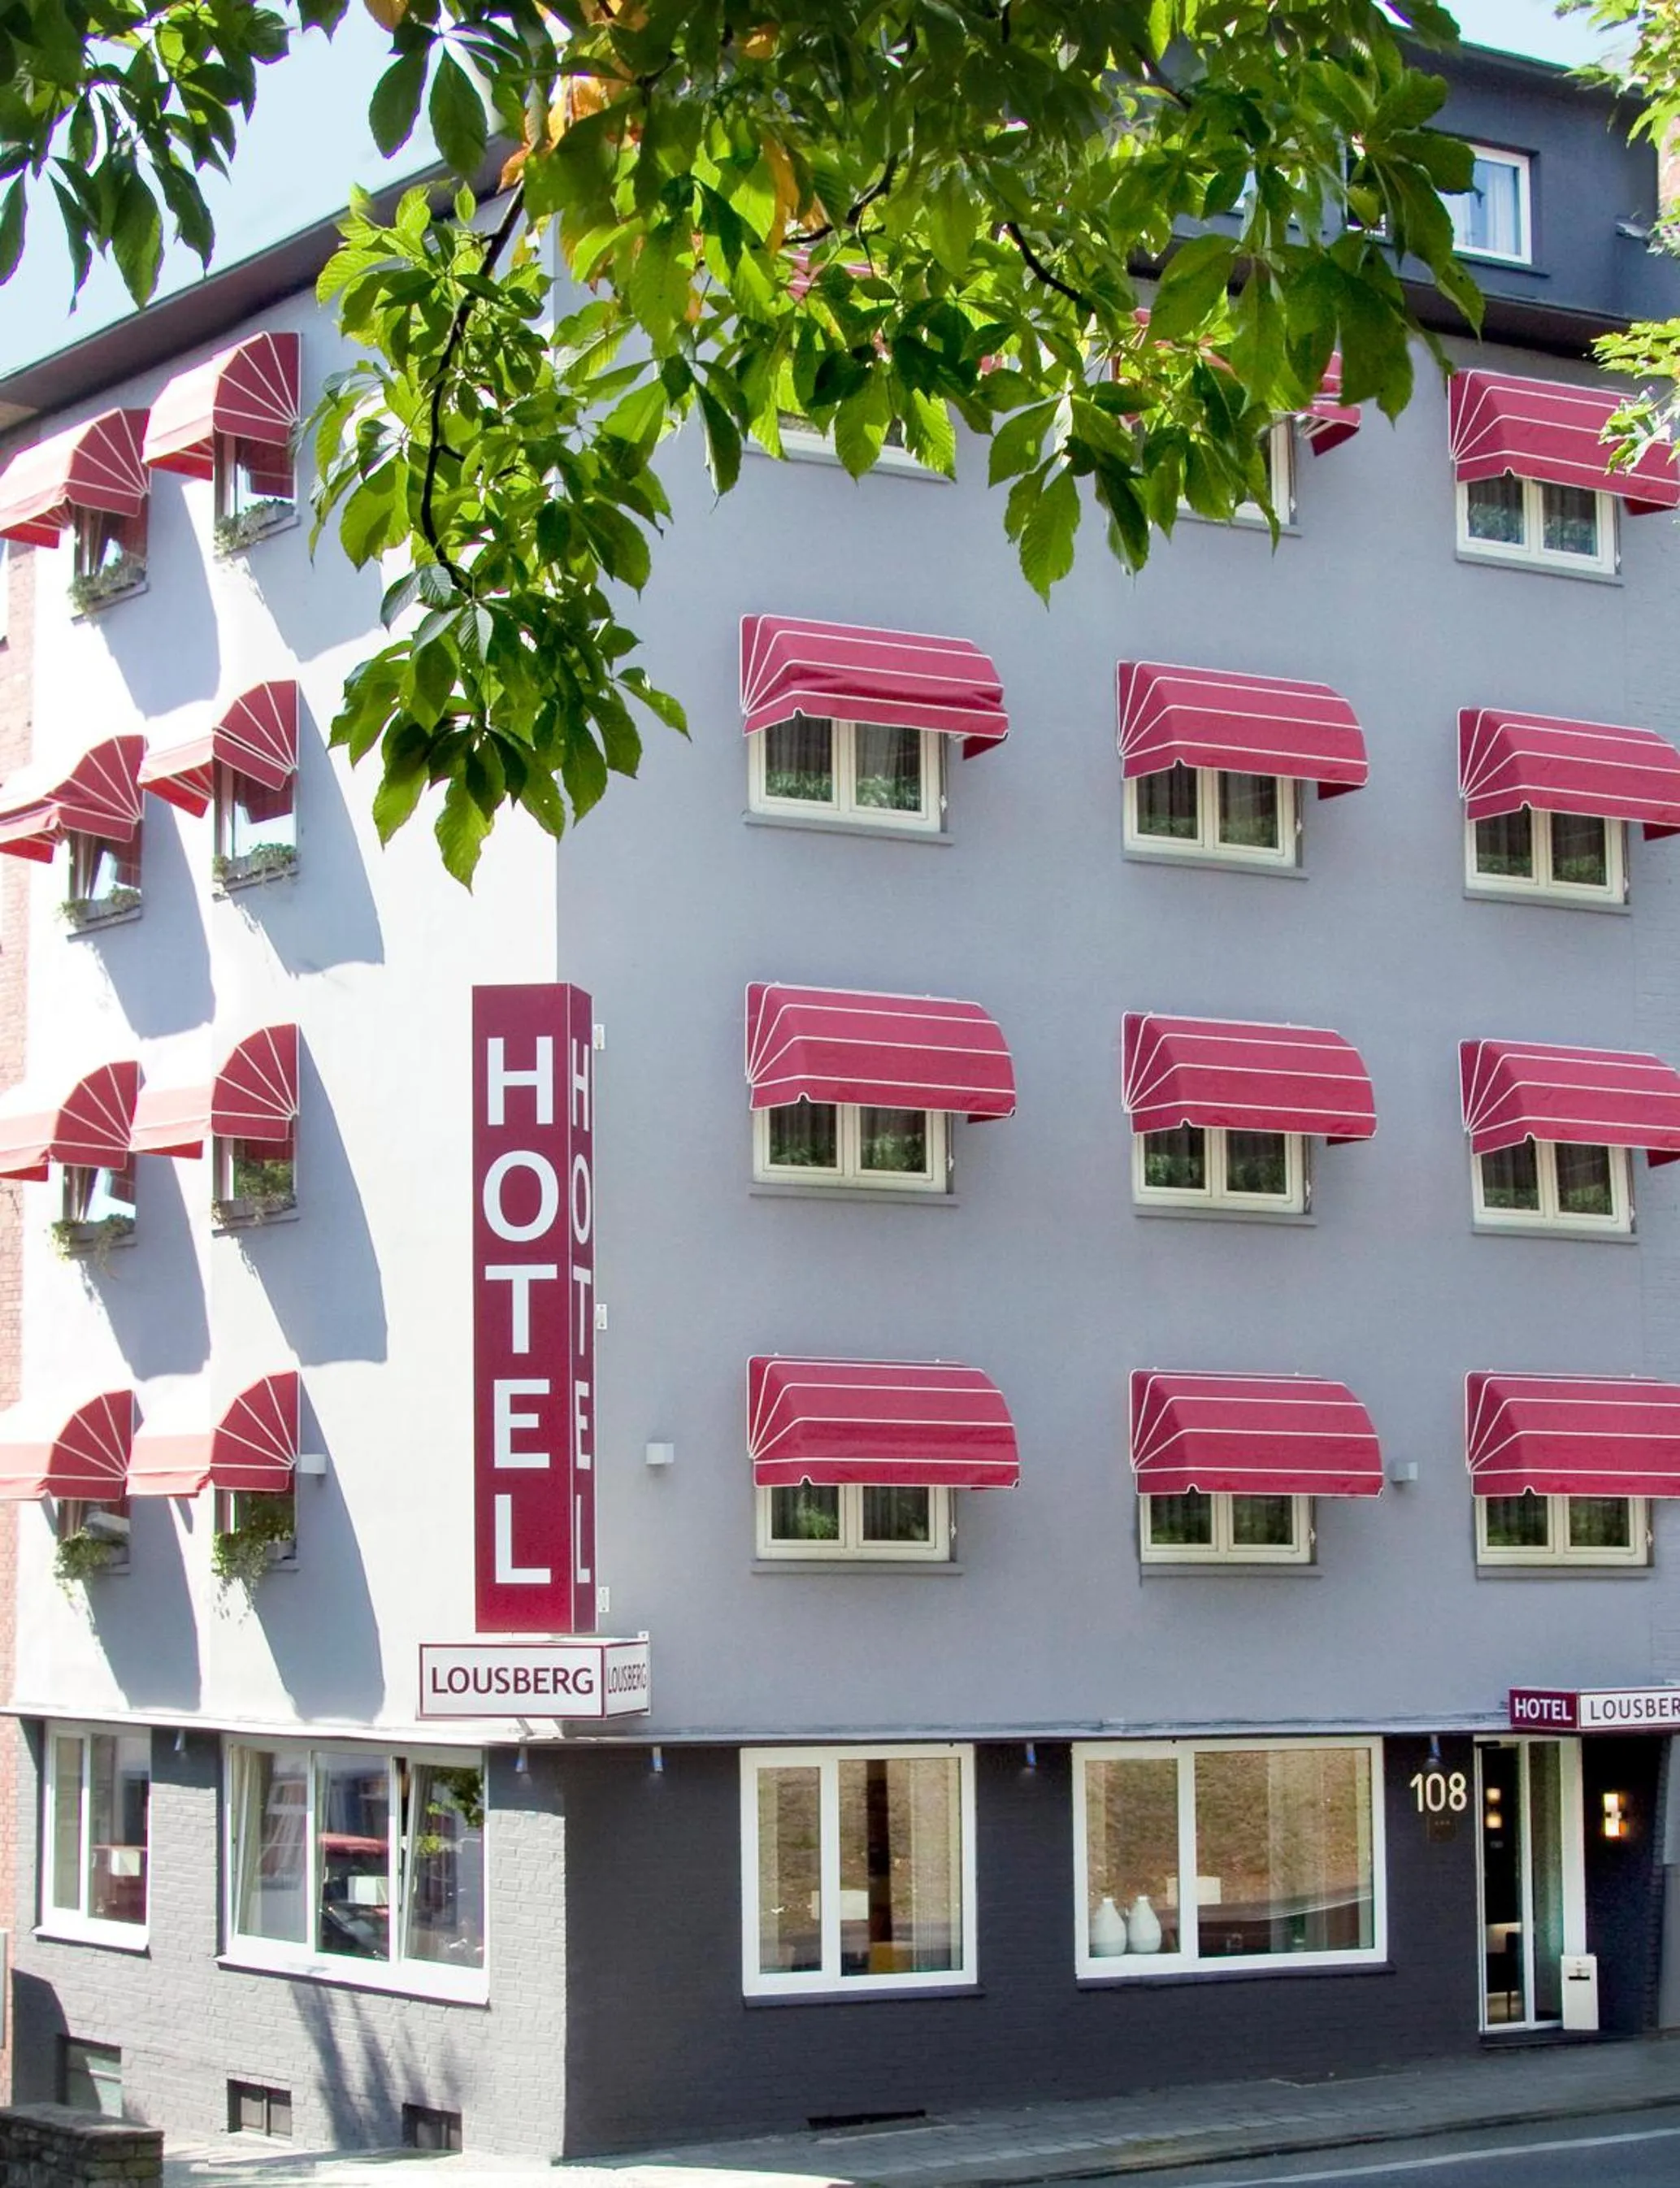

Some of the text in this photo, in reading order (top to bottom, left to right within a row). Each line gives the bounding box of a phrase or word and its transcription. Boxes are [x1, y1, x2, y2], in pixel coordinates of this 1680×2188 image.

[483, 1036, 559, 1584] HOTEL
[571, 1038, 592, 1583] HOTEL
[432, 1666, 593, 1695] LOUSBERG
[608, 1663, 647, 1693] LOUSBERG
[1514, 1697, 1573, 1721] HOTEL
[1410, 1773, 1467, 1812] 108
